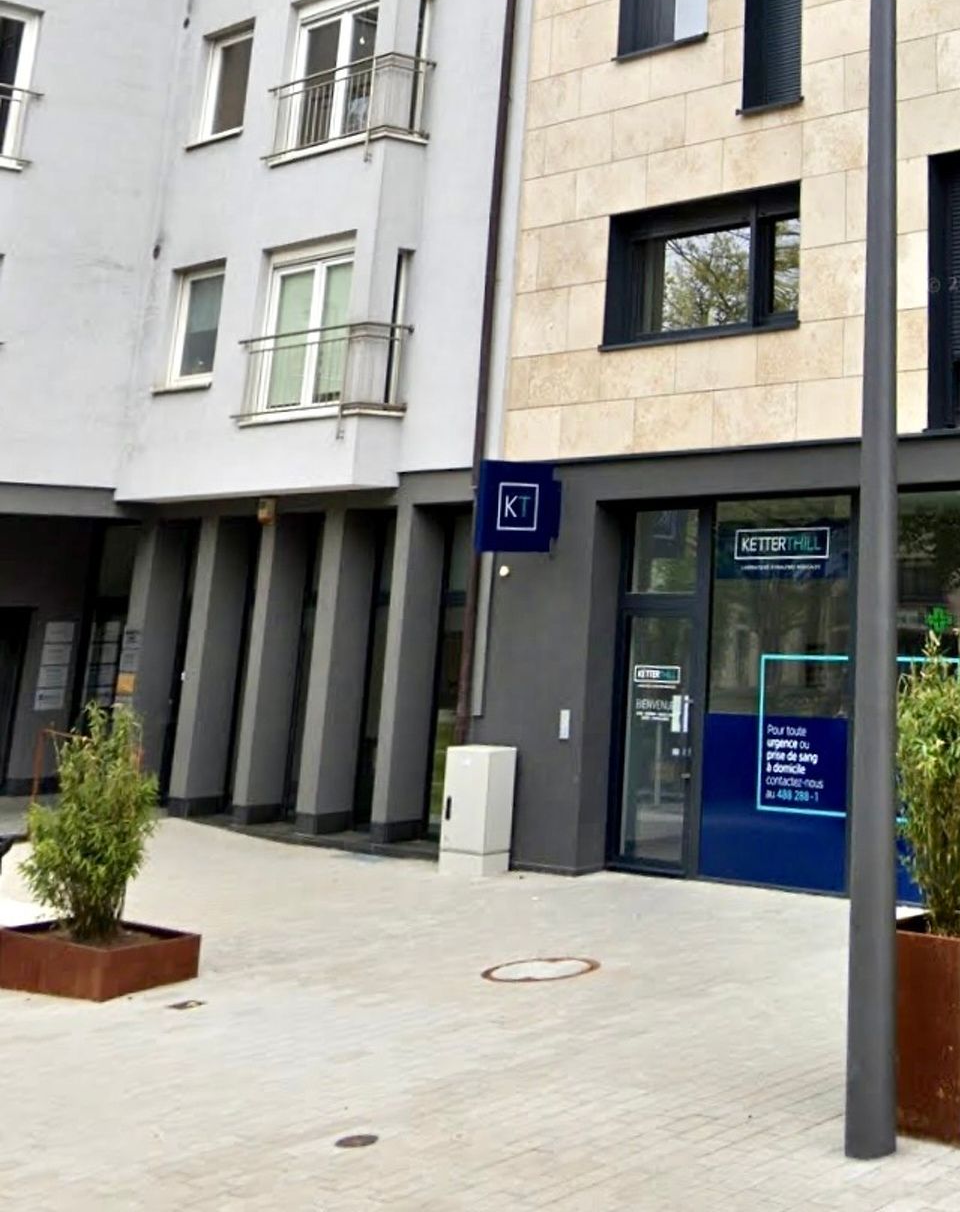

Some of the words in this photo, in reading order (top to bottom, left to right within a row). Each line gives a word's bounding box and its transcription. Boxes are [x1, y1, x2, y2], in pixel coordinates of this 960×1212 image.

[504, 495, 532, 518] KT
[741, 535, 822, 552] KETTERTHILL
[766, 723, 785, 736] Pour
[786, 726, 807, 737] toute
[766, 739, 798, 750] urgence
[800, 740, 810, 749] ou
[766, 750, 786, 761] prise
[786, 750, 798, 761] de
[799, 753, 818, 765] sang
[773, 762, 806, 775] domicile
[765, 789, 775, 799] au
